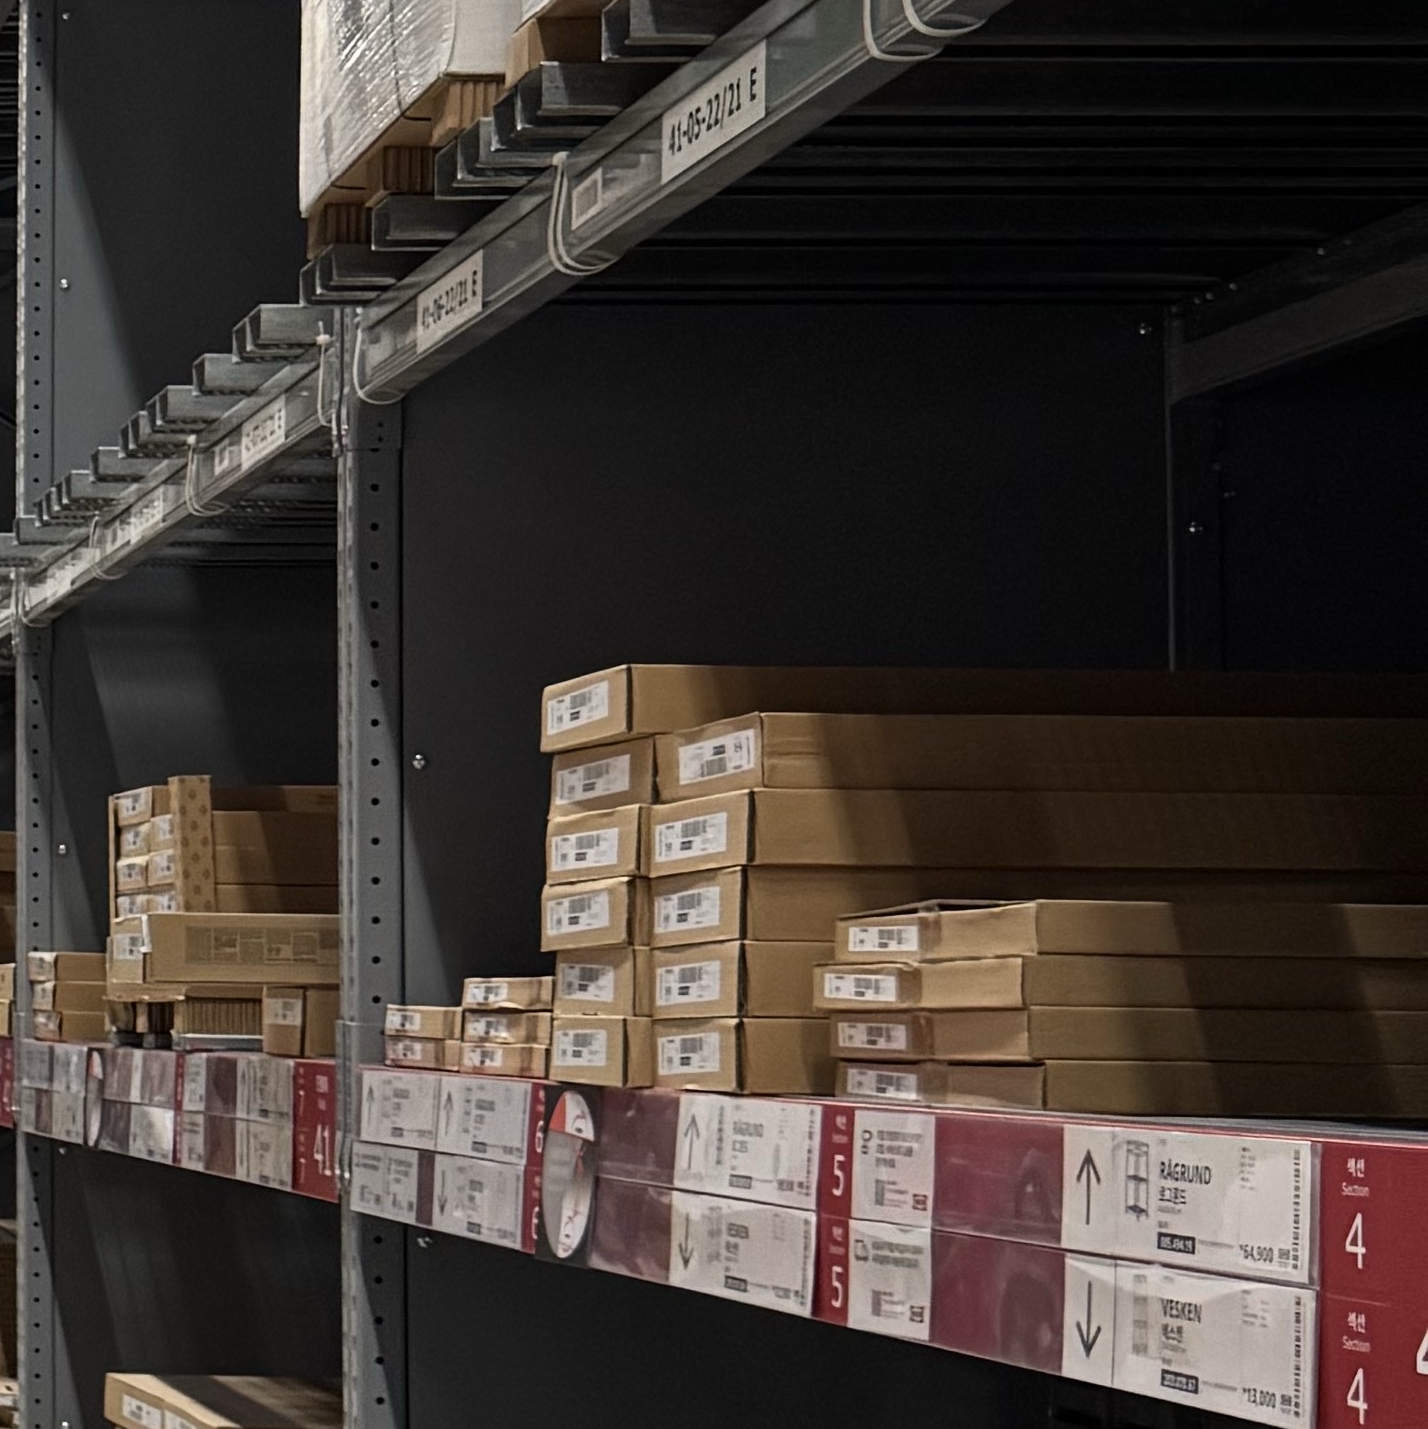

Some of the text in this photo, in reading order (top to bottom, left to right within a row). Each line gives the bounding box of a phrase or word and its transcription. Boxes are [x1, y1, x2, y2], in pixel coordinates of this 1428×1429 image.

[667, 67, 758, 156] 41-05-22/21 E
[831, 1154, 846, 1197] 5
[1159, 1158, 1212, 1186] RÅGRUND
[1345, 1212, 1367, 1269] 4
[831, 1265, 844, 1308] 5
[1161, 1297, 1202, 1324] VESKEN
[1346, 1367, 1368, 1426] 4
